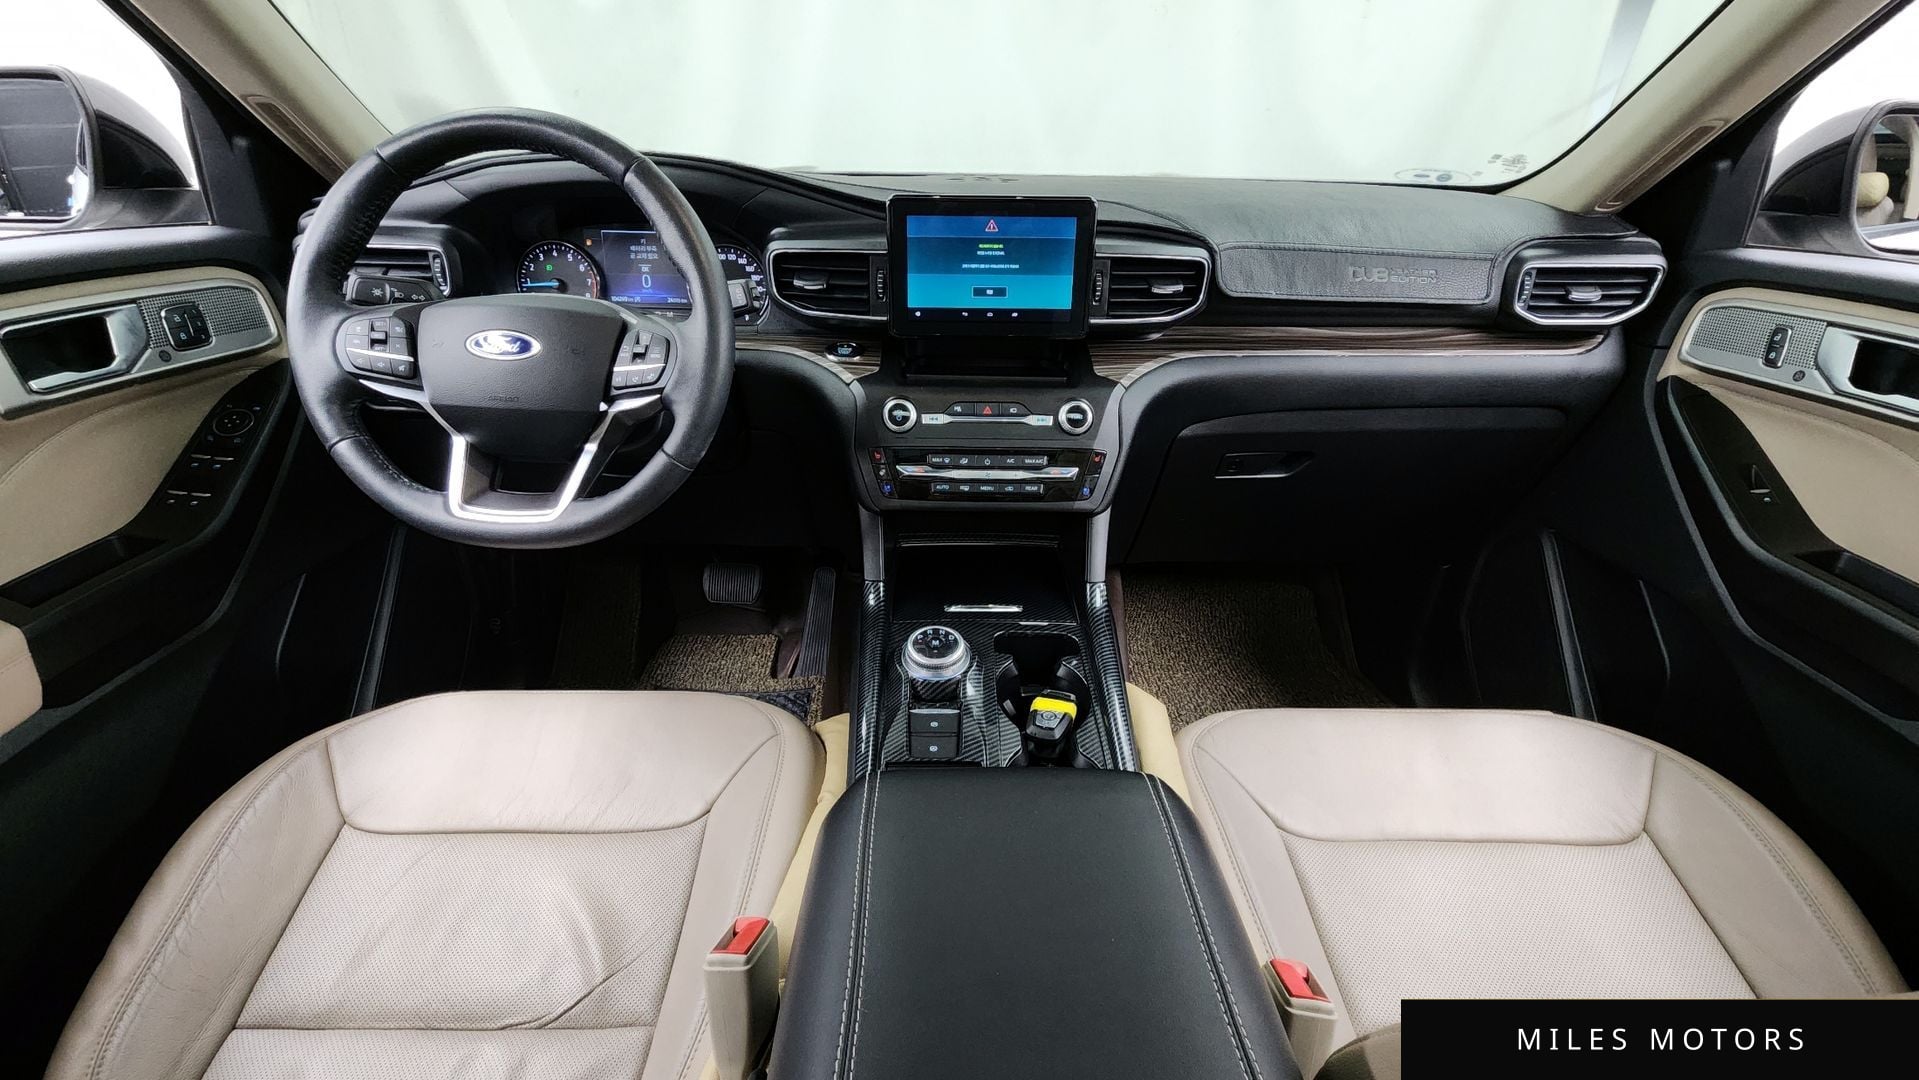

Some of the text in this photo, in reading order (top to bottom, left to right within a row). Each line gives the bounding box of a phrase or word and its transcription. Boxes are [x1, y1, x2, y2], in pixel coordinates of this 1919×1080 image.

[538, 253, 544, 261] 3
[552, 249, 558, 257] 4
[567, 253, 573, 262] 5
[529, 263, 535, 271] 2
[579, 263, 585, 272] 6
[586, 278, 592, 286] 7
[642, 274, 652, 288] 0
